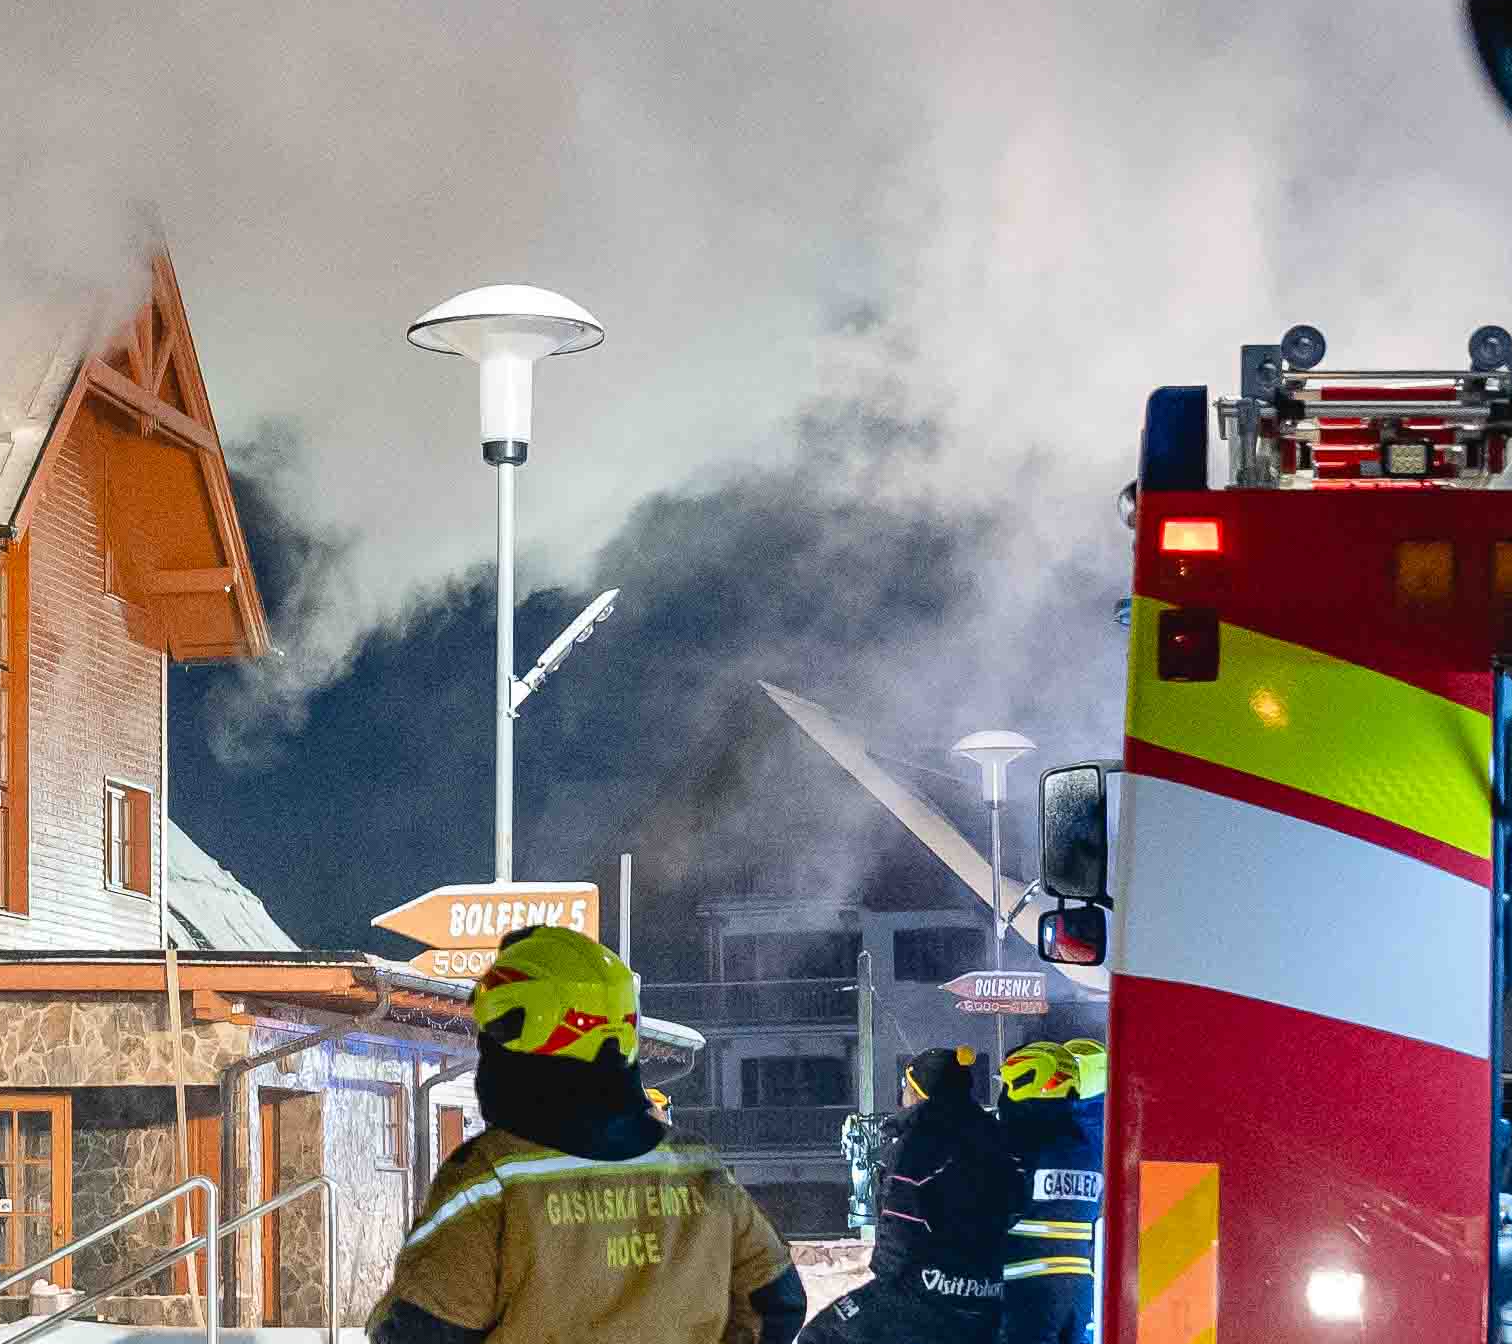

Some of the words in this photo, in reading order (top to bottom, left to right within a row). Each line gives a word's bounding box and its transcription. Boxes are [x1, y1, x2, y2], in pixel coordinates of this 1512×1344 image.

[448, 901, 564, 937] BOLFENK
[569, 899, 588, 931] 5
[975, 977, 1031, 997] BOLFENK
[546, 1186, 639, 1226] GASILSKA
[644, 1184, 706, 1218] ENOTA
[607, 1227, 662, 1268] HOČE
